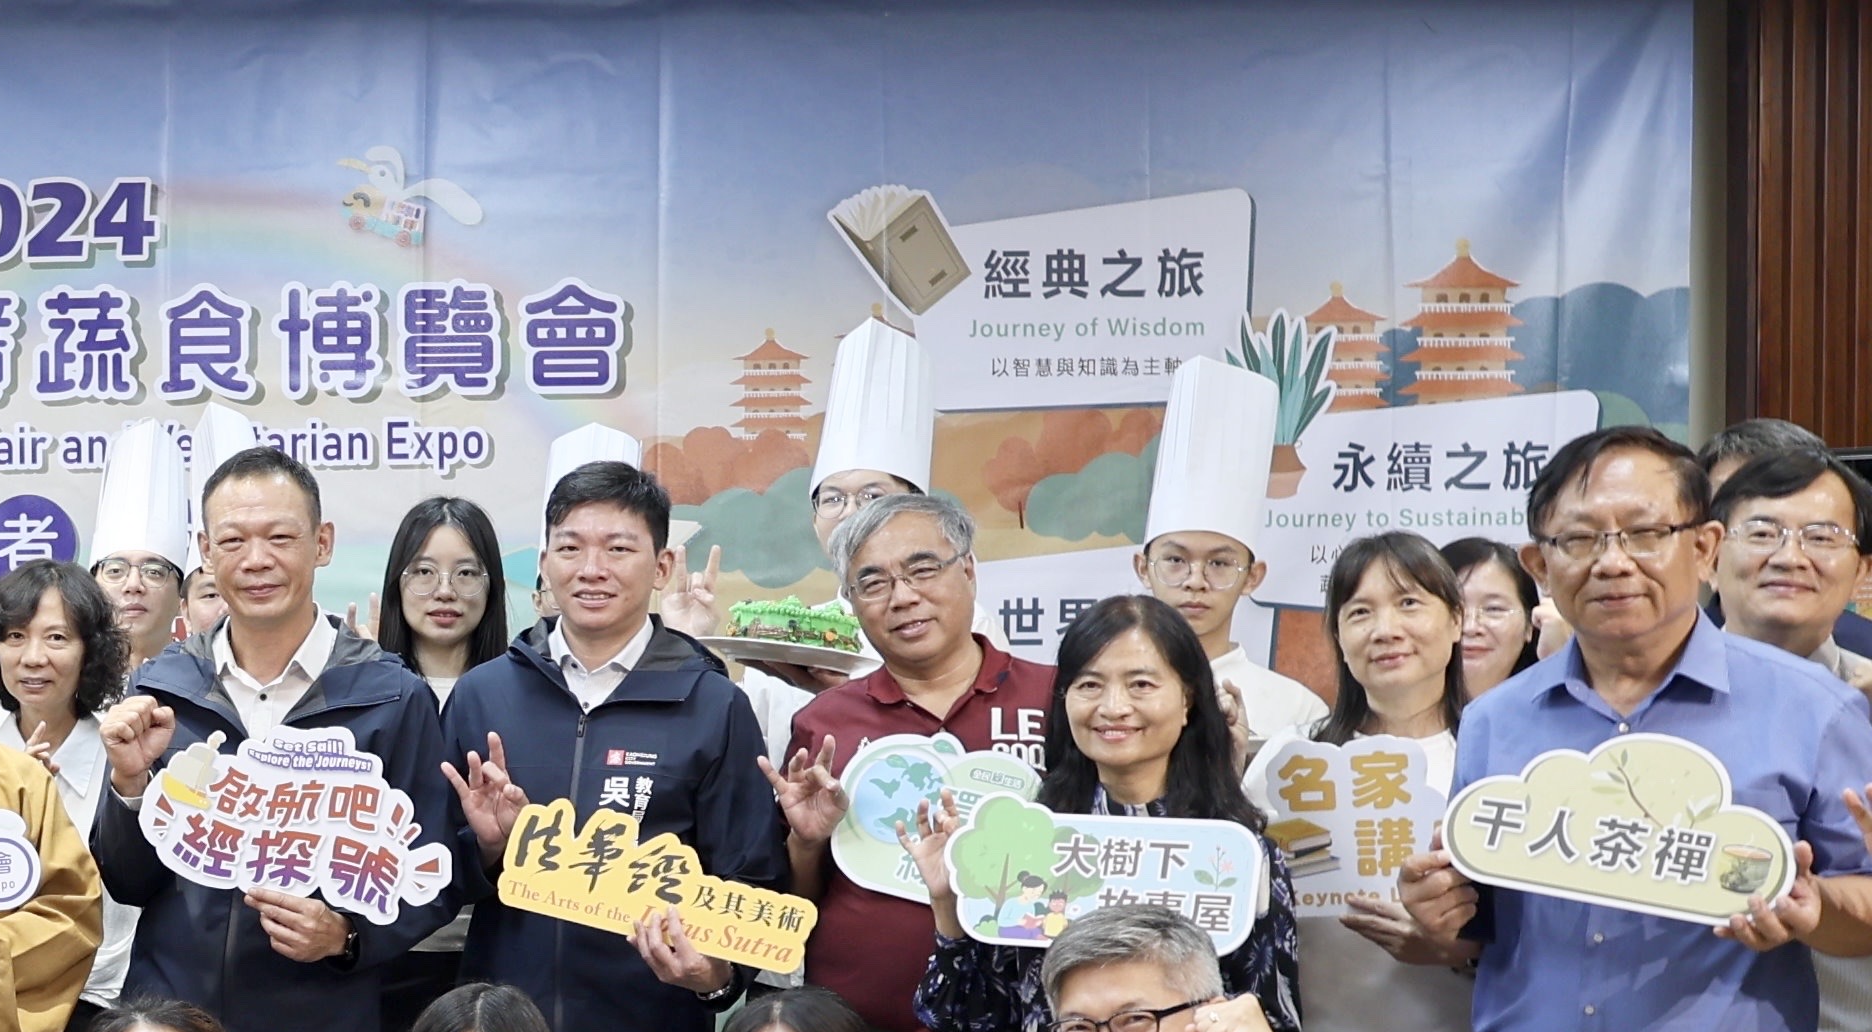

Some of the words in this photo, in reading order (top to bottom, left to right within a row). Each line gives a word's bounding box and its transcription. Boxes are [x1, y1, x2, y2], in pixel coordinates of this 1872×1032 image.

[984, 248, 1204, 299] 經典之旅
[969, 319, 1066, 342] Journey
[1075, 317, 1099, 338] of
[1107, 316, 1205, 338] Wisdom
[387, 421, 485, 471] Expo
[1332, 441, 1549, 492] 永續之旅
[1265, 508, 1356, 532] Journey
[1367, 509, 1389, 528] to
[273, 738, 303, 752] Set
[306, 739, 344, 755] Sail!
[292, 753, 314, 769] the
[599, 776, 631, 807] 吳
[1279, 750, 1412, 812] 名家
[172, 813, 399, 914] 經探號
[1054, 836, 1190, 880] 大樹下
[508, 880, 540, 902] The
[543, 890, 579, 912] Arts
[584, 901, 604, 915] of
[606, 906, 631, 924] the
[717, 924, 793, 964] Sutra
